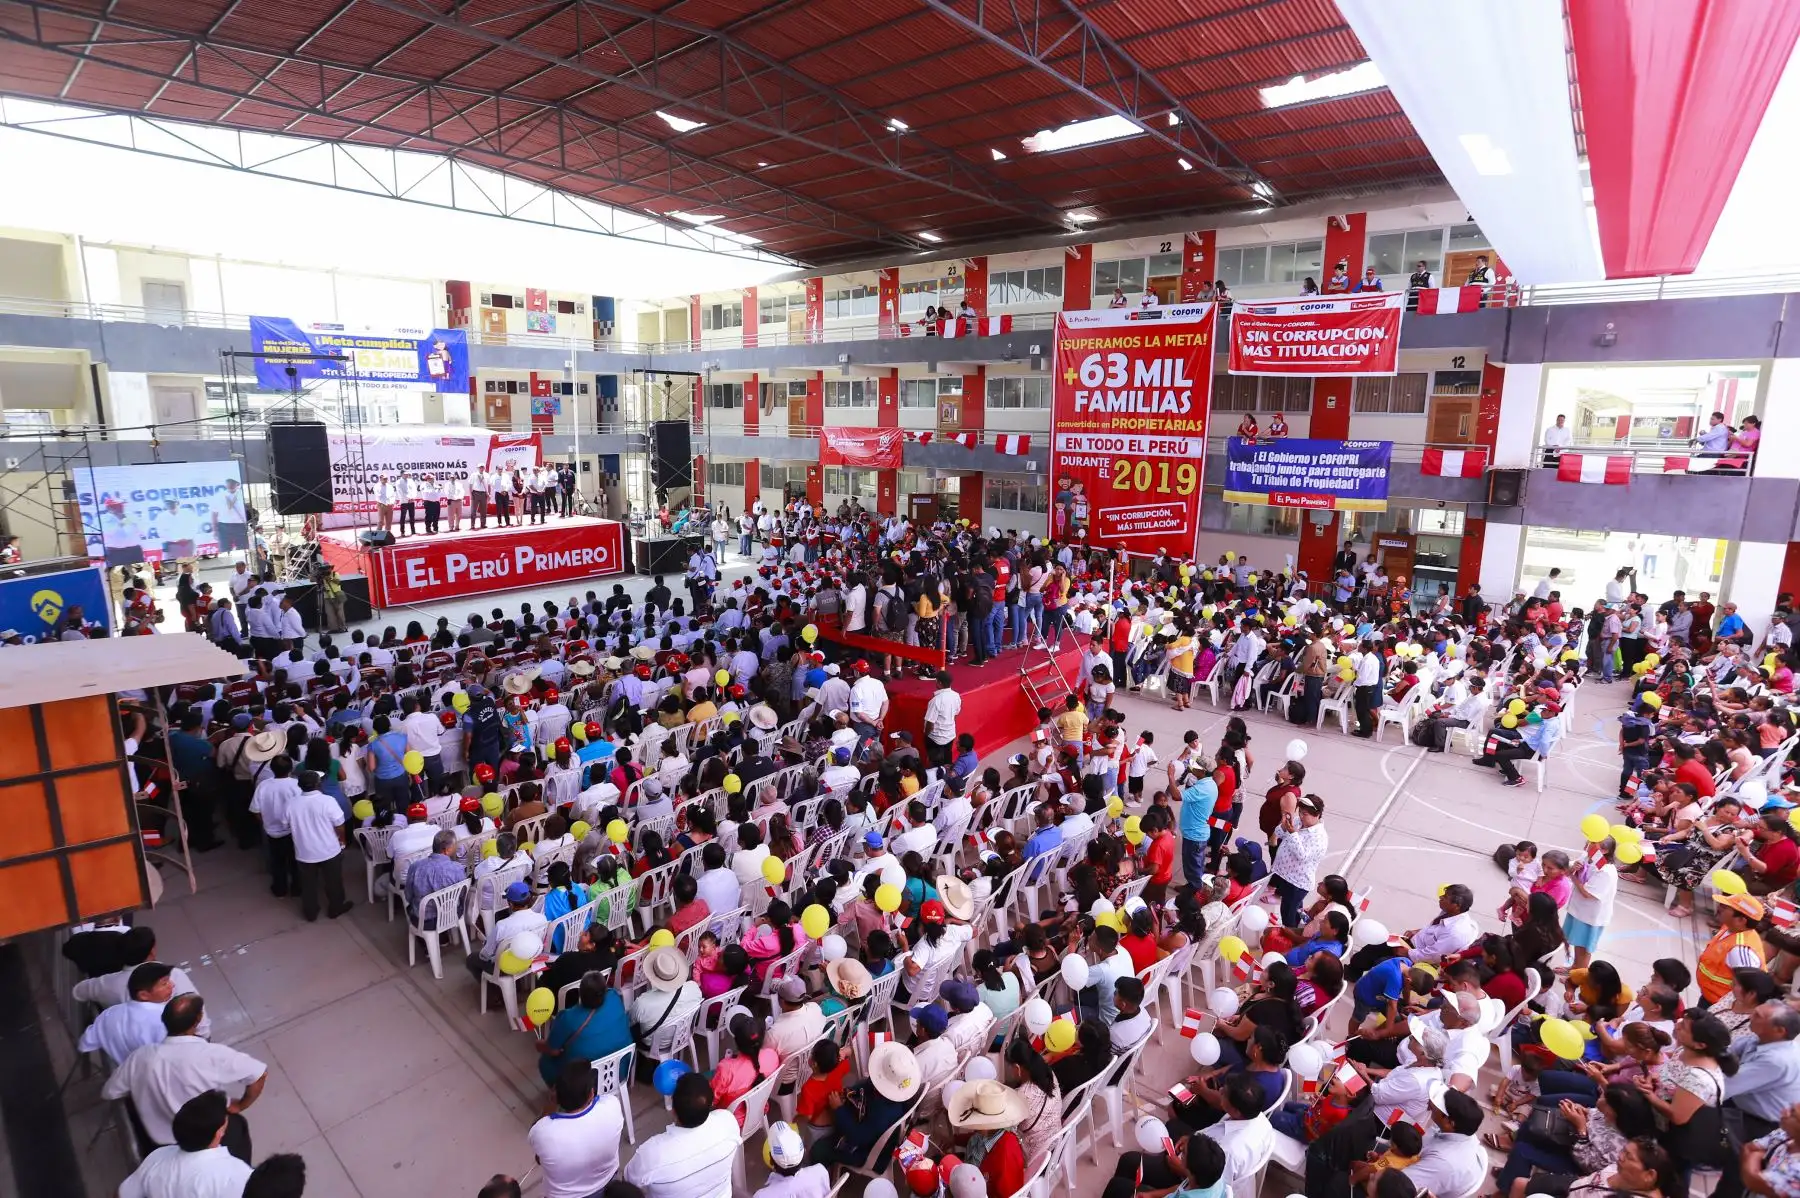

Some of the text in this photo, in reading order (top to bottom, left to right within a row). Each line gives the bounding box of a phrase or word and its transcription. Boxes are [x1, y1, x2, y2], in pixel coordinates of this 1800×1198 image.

[1160, 241, 1172, 252] 22
[948, 266, 957, 275] 23
[1171, 308, 1204, 316] COFOPRI
[1301, 303, 1334, 311] COFOPRI
[1060, 333, 1208, 351] ¡SUPERAMOS LA META!
[1245, 330, 1269, 342] SIN
[263, 345, 312, 354] MUJERES
[1243, 343, 1272, 357] MÁS
[1278, 343, 1370, 357] TITULACIÓN
[357, 350, 416, 369] 63 MIL
[1452, 356, 1465, 368] 12
[360, 370, 371, 378] DE
[372, 370, 419, 379] PROPIEDAD
[1133, 358, 1193, 388] MIL
[1074, 389, 1193, 414] FAMILIAS
[1057, 419, 1100, 429] convertidas
[1111, 417, 1203, 432] PROPIETARIAS
[1066, 437, 1189, 455] EN TODO EL PERÚ
[1348, 441, 1381, 449] COFOPRI
[1061, 456, 1110, 468] DURANTE
[1258, 451, 1267, 462] El
[1268, 451, 1310, 464] Gobierno
[1311, 456, 1318, 466] y
[1319, 453, 1360, 465] COFOPRI
[333, 459, 468, 472] GRACIAS AL GOBIERNO MÁS
[1230, 461, 1386, 480] trabajando juntos para entregarte
[333, 472, 382, 485] TÍTULO
[1099, 467, 1110, 478] EL
[1112, 459, 1198, 496] 2019
[1251, 473, 1262, 485] Tu
[1264, 474, 1289, 487] Título
[1290, 475, 1301, 487] de
[1303, 476, 1354, 490] Propiedad
[334, 487, 363, 496] PARA
[1121, 508, 1173, 521] CORRUPCIÓN,
[1117, 521, 1133, 532] MÁS
